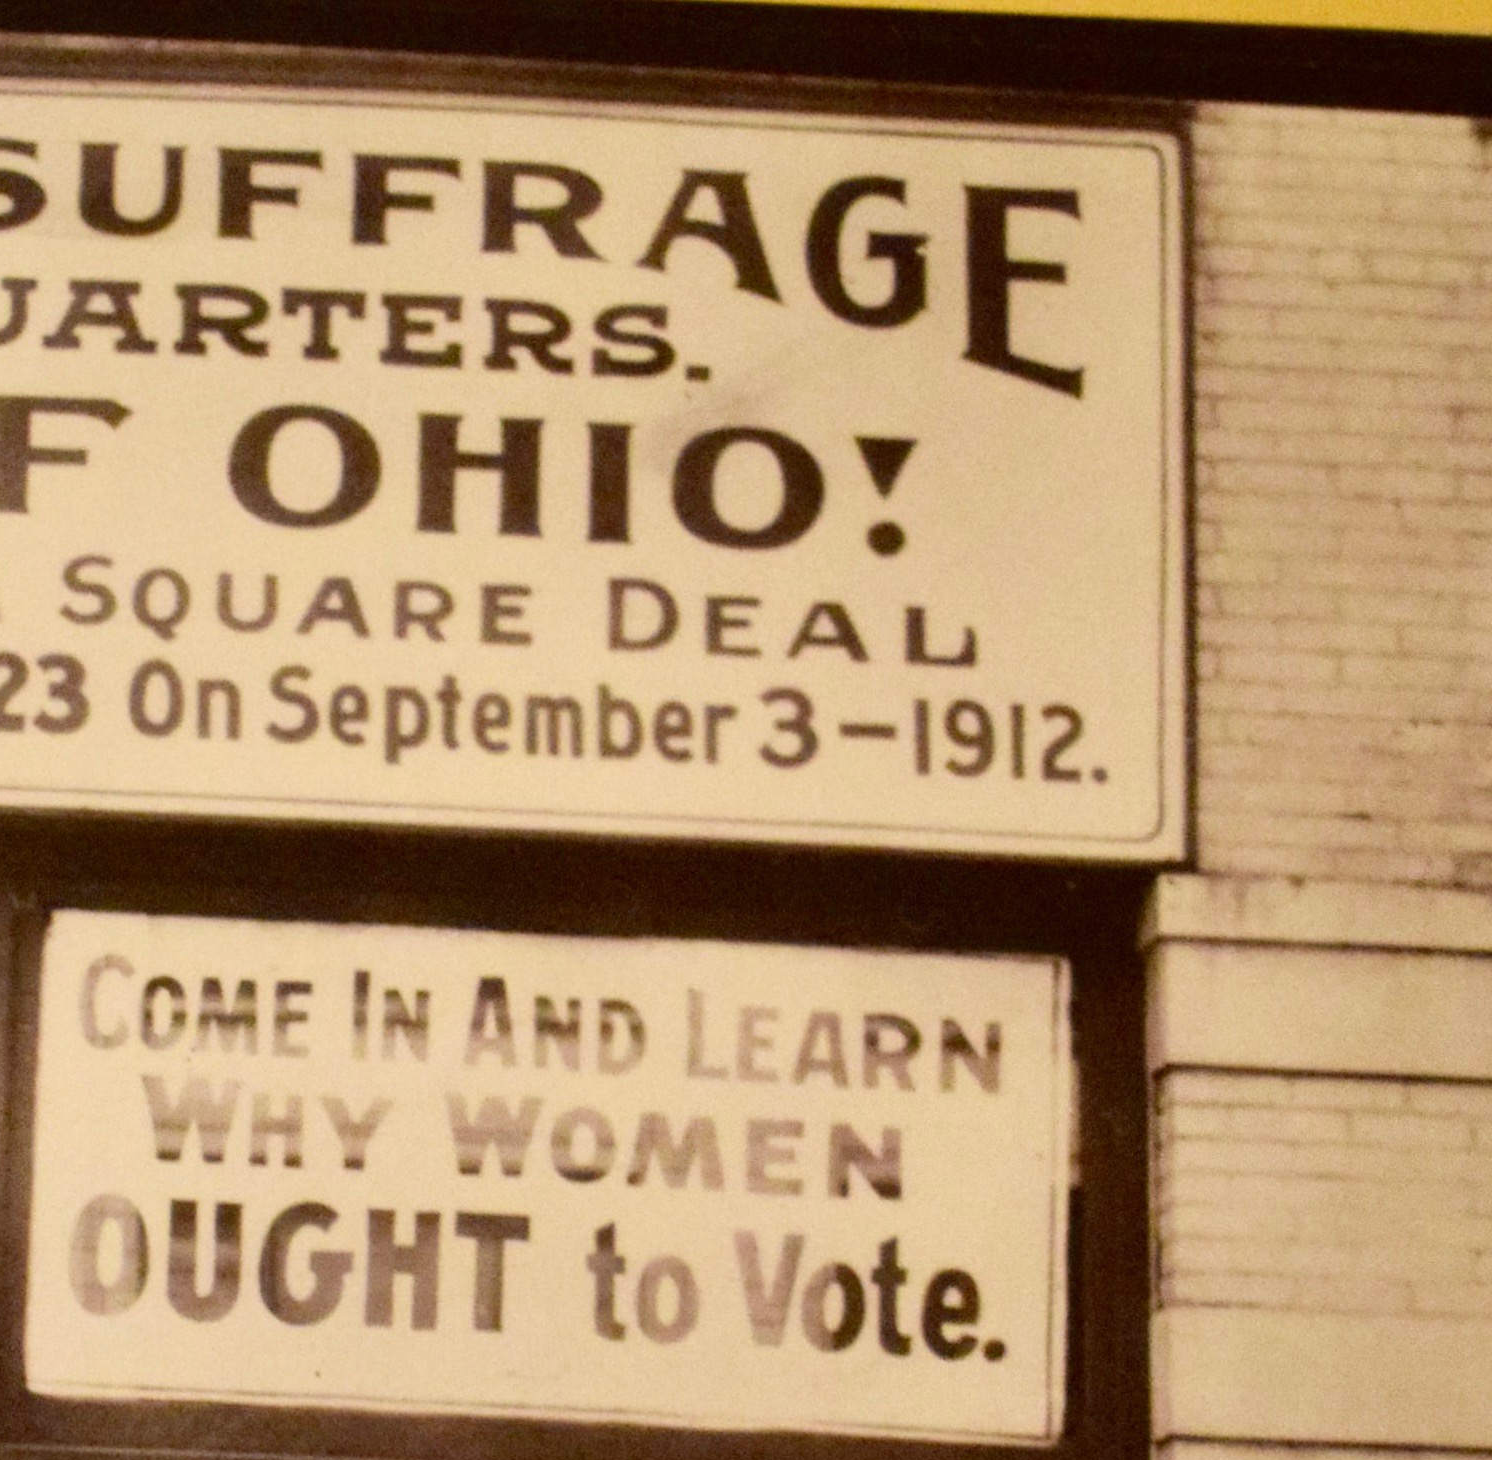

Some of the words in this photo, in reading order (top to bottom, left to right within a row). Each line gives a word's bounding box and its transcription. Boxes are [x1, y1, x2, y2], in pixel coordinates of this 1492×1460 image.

[227, 403, 918, 558] OHIO!
[60, 555, 532, 646] SQUARE
[608, 577, 978, 668] DEAL
[128, 658, 241, 740] On
[266, 665, 738, 764] September
[78, 954, 314, 1060] COME
[352, 970, 432, 1062] IN
[462, 976, 647, 1074] AND
[684, 988, 1003, 1094] LEARN
[141, 1074, 393, 1172] WHY
[444, 1092, 903, 1201] WOMEN
[68, 1193, 531, 1333] OUGHT
[586, 1222, 699, 1342] to
[734, 1230, 1009, 1363] Vote.
